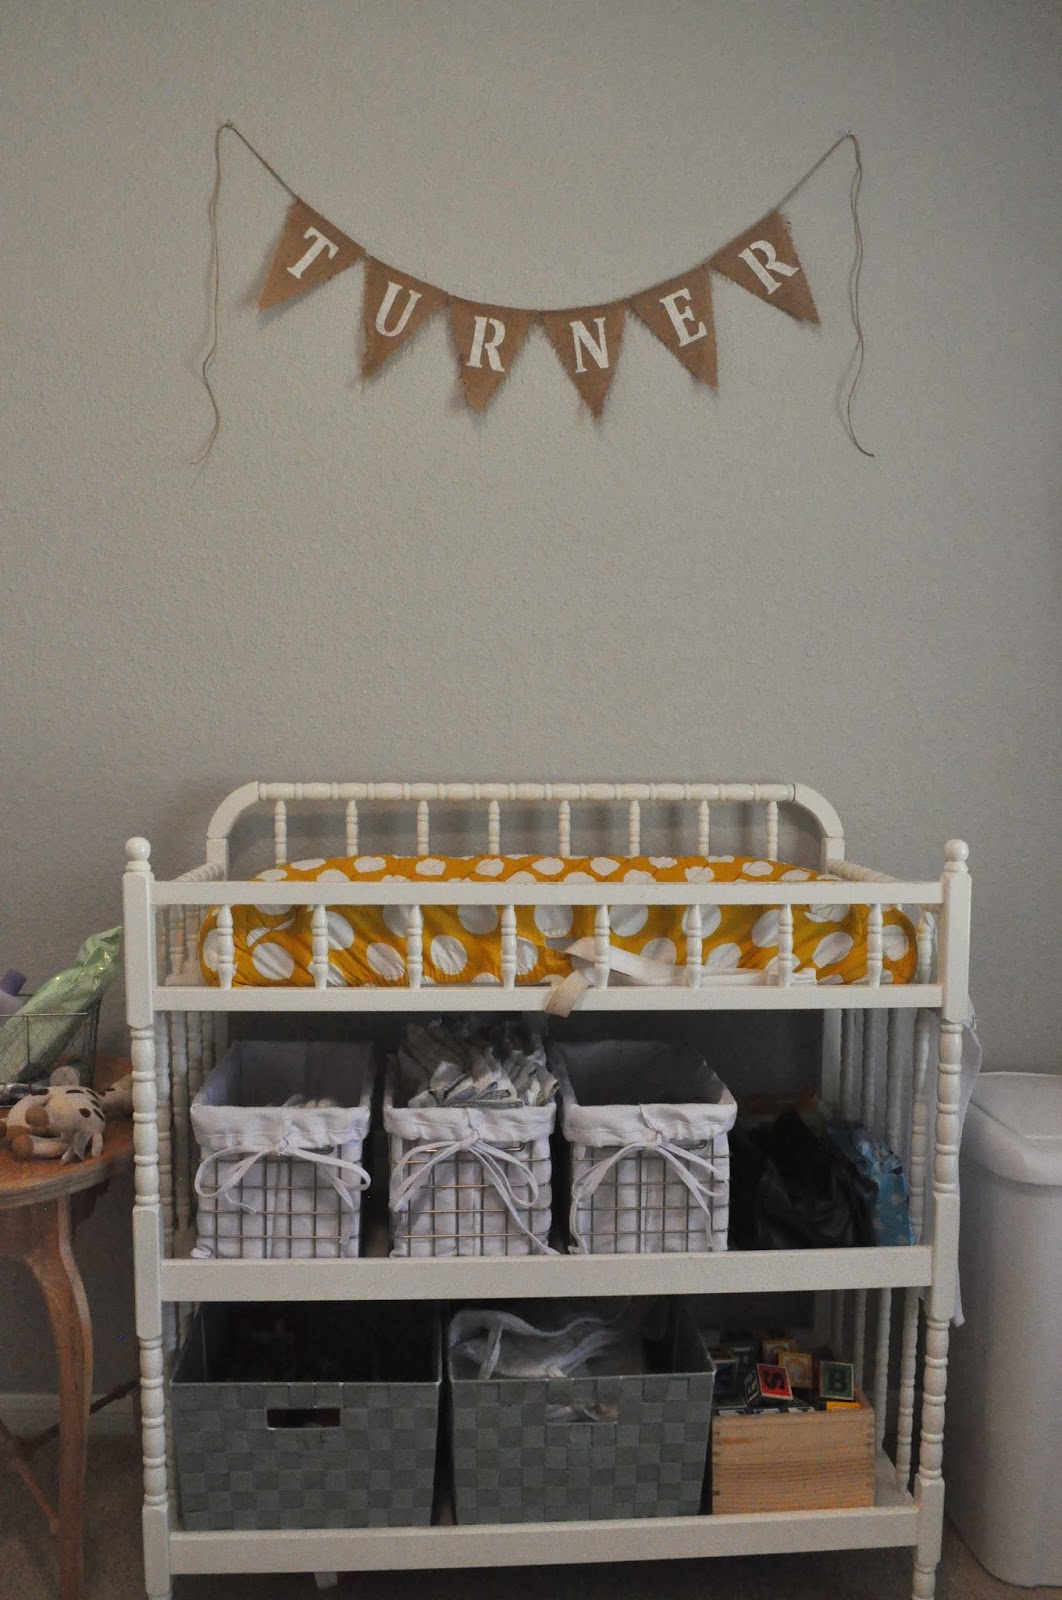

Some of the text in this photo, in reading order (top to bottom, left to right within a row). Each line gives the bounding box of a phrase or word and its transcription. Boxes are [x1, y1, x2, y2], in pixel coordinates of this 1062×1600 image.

[286, 226, 800, 373] TURNER
[763, 1369, 786, 1390] S
[826, 1367, 848, 1393] B
